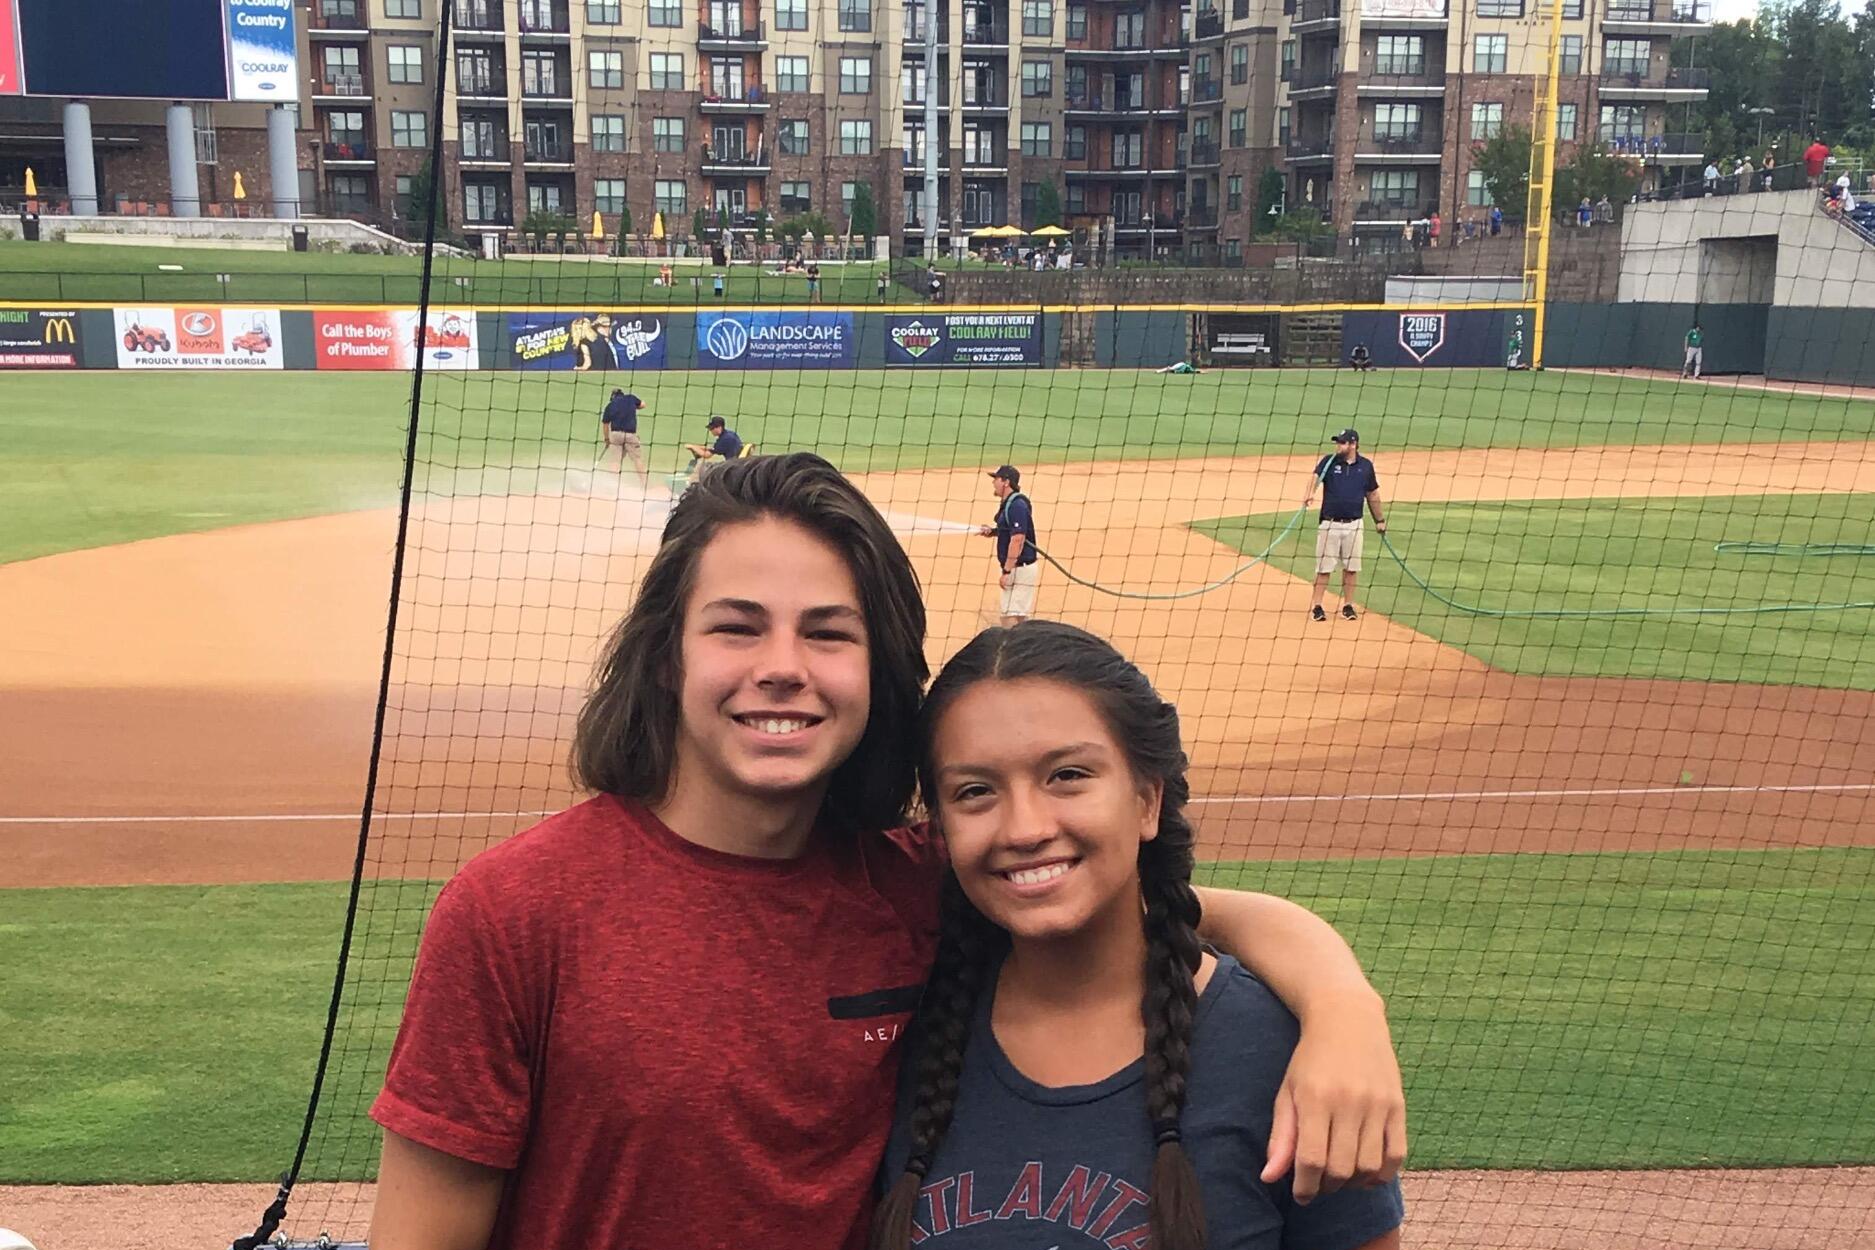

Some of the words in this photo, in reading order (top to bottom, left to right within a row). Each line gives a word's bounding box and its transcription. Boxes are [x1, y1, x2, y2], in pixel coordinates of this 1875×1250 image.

[236, 12, 287, 30] Country
[241, 62, 289, 73] COOLRAY
[1406, 317, 1438, 333] 2016
[321, 323, 343, 338] Call
[344, 324, 364, 338] the
[365, 324, 393, 341] Boys
[750, 325, 843, 340] LANDSCAPE
[891, 327, 939, 338] COOLRAY
[949, 326, 997, 339] COOLRAY
[327, 342, 340, 356] of
[341, 342, 390, 356] Plumber
[750, 341, 807, 352] Management
[808, 341, 843, 350] Services
[135, 357, 179, 366] PROUDLY
[182, 357, 209, 366] BUILT
[211, 357, 223, 366] IN
[224, 357, 267, 366] GEORGIA
